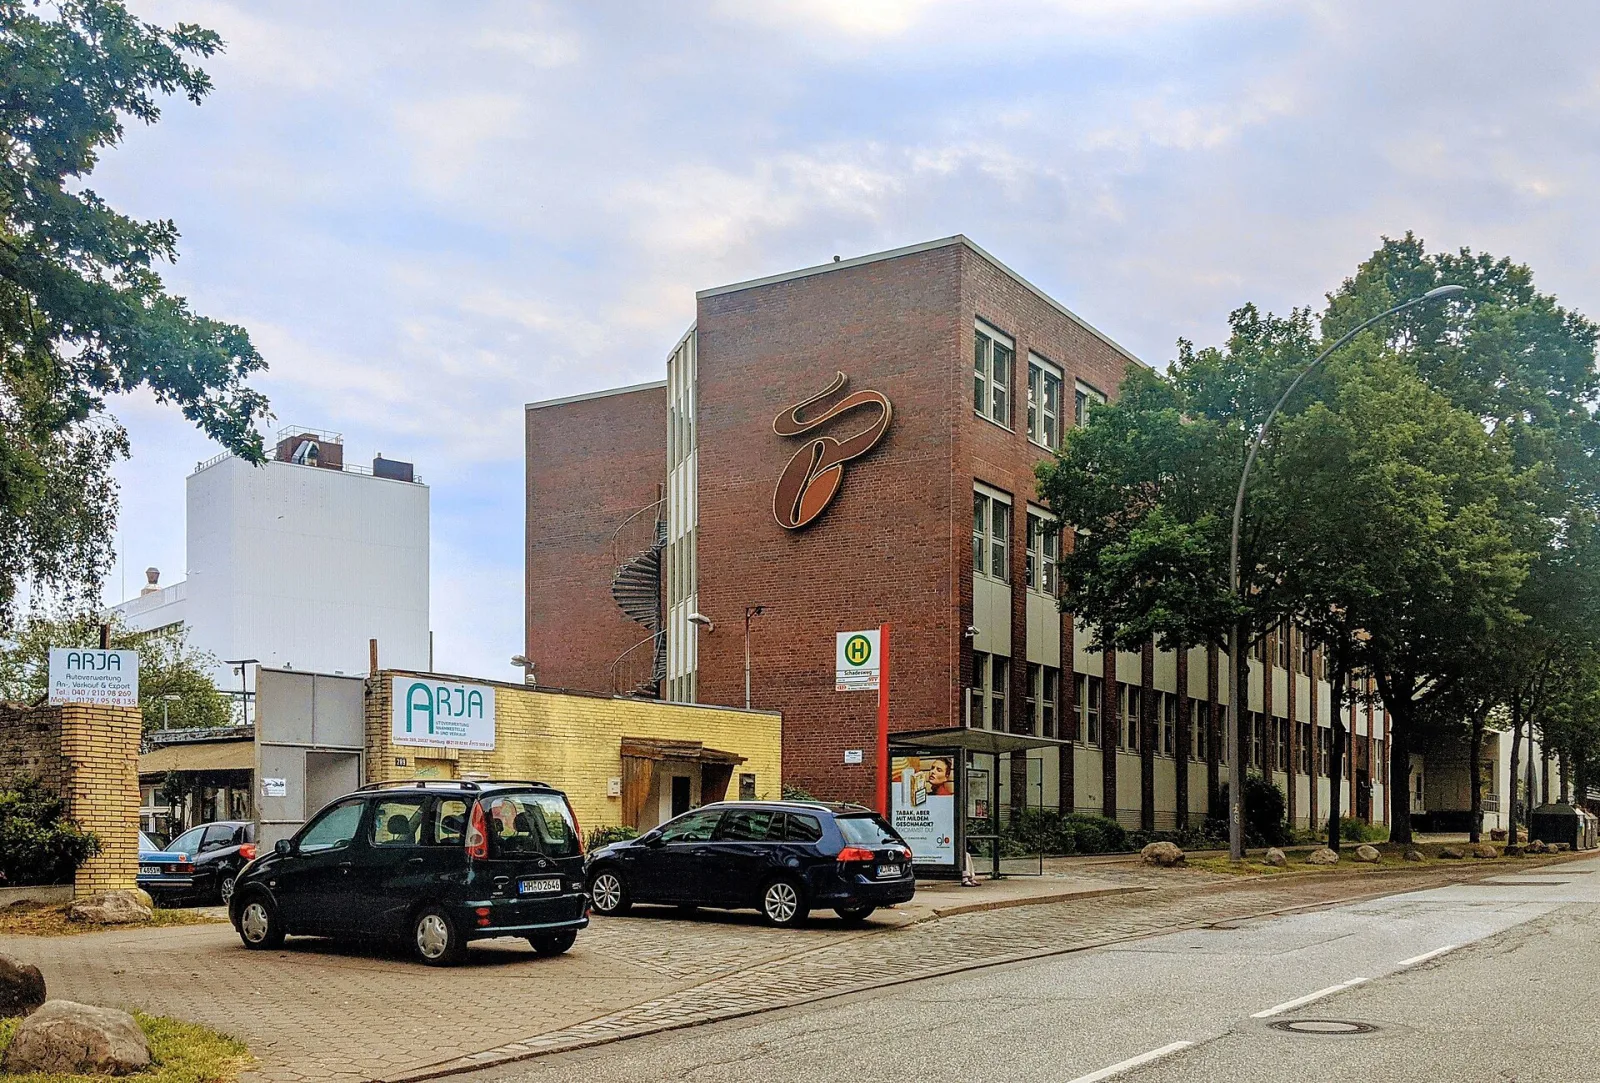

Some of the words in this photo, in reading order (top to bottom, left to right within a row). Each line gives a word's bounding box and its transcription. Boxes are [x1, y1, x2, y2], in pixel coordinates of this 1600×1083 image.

[852, 641, 864, 659] H
[67, 652, 121, 671] ARJA
[66, 673, 122, 682] Autoverwertung
[406, 682, 483, 734] ARJA
[937, 833, 950, 847] glo
[523, 882, 534, 891] HH
